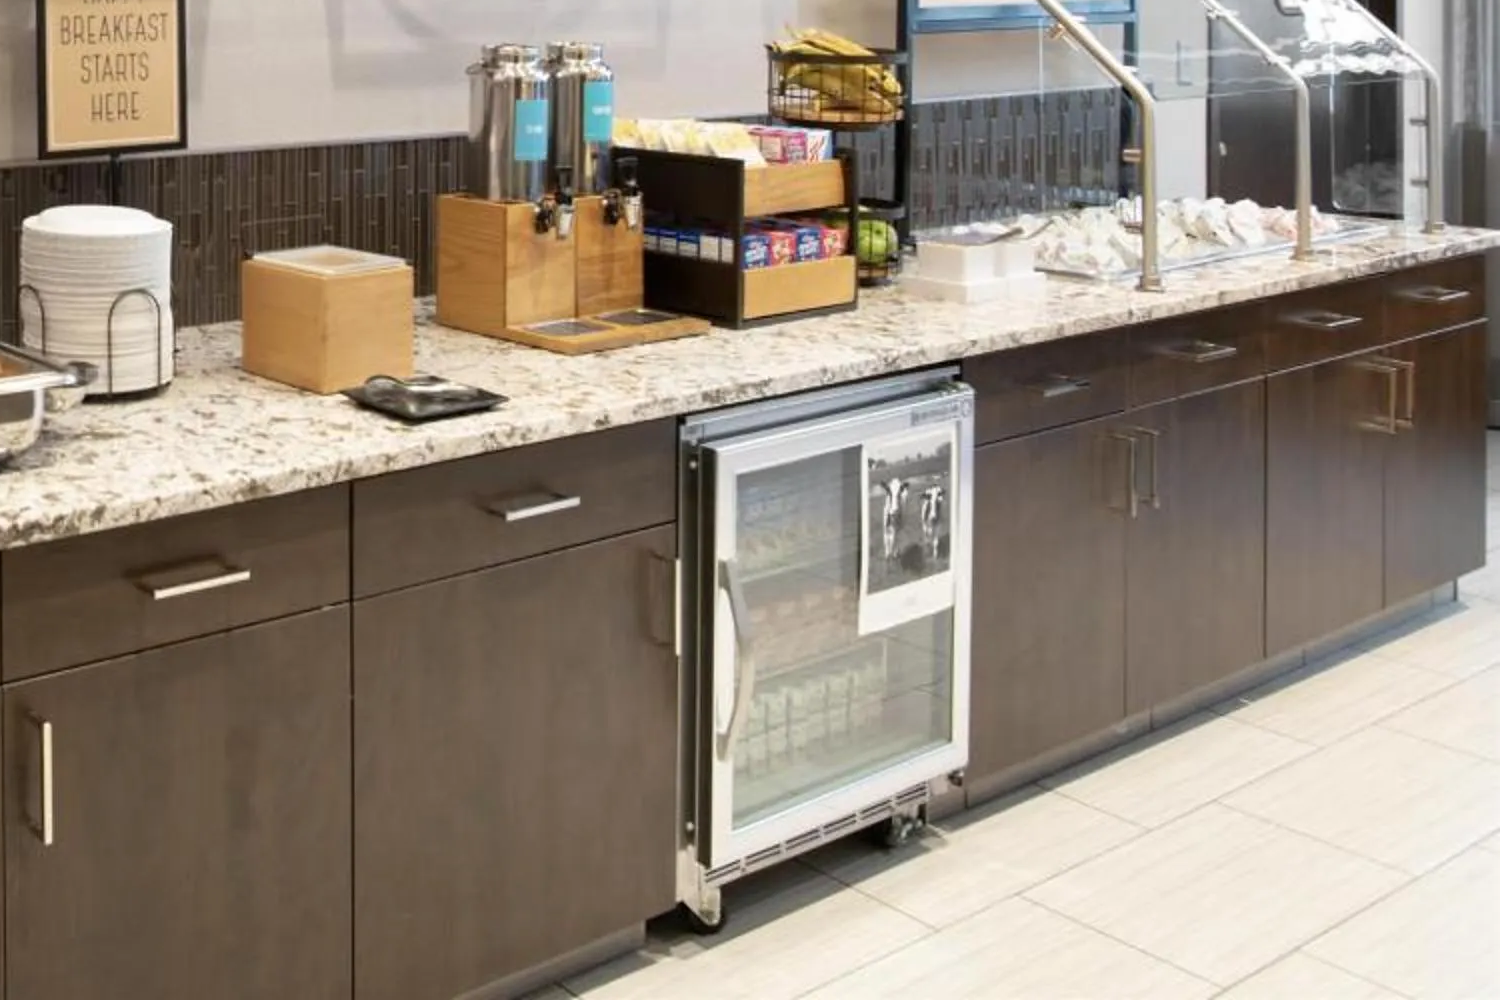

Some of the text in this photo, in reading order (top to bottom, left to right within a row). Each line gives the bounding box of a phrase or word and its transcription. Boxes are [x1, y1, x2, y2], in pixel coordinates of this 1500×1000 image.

[59, 12, 169, 45] BREAKFAST
[79, 51, 150, 84] STARTS
[90, 90, 141, 122] HERE
